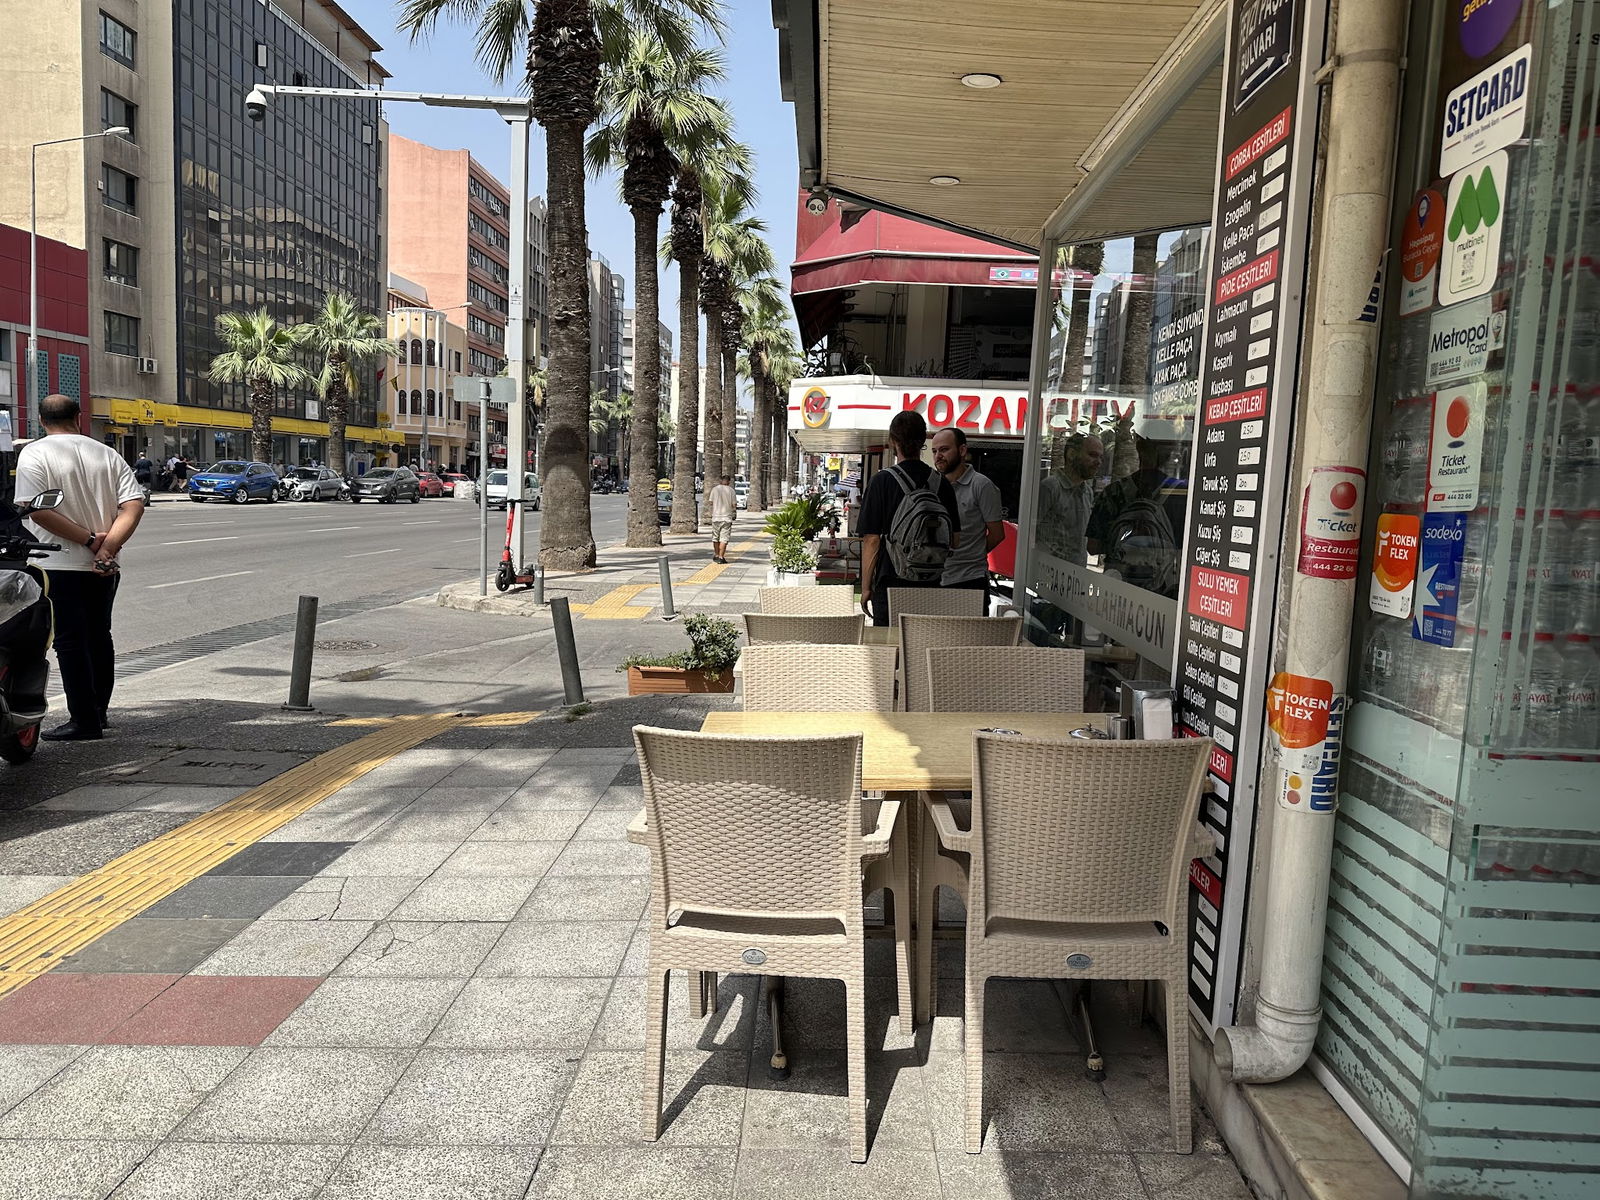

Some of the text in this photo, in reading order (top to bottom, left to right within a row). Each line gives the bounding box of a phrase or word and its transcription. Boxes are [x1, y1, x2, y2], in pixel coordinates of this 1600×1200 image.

[1240, 21, 1277, 76] BULVARI
[1446, 57, 1527, 138] SETCARD
[1230, 113, 1286, 176] ÇORBA ÇEŞİTLERİ
[1227, 168, 1257, 203] Mercimek
[1225, 199, 1251, 228] Ezogelin
[1222, 231, 1238, 252] Kelle
[1238, 223, 1254, 243] Paça
[1221, 250, 1247, 276] İşkembe
[1220, 255, 1273, 299] PİDE ÇEŞİTLERİ
[1217, 299, 1248, 323] Lahmacun
[1157, 315, 1177, 344] KENDİ
[1214, 325, 1238, 348] Kıymalı
[1431, 317, 1489, 354] Metropol
[1155, 335, 1194, 365] KELLE PAÇA
[1468, 340, 1488, 356] Card
[1153, 360, 1188, 386] AYAK PAÇA
[1212, 351, 1234, 372] Kaşarlı
[1178, 378, 1199, 403] ÇORB
[1210, 378, 1234, 396] Kuşbaşı
[1208, 391, 1264, 420] KEBAP ÇEŞİTLERİ
[1205, 428, 1225, 443] Adana
[1204, 452, 1217, 467] Urfa
[1441, 455, 1466, 467] Ticket
[1202, 475, 1219, 491] Tavuk
[1219, 475, 1229, 494] Şiş
[1200, 500, 1217, 515] Kanat
[1217, 500, 1227, 518] Şiş
[1197, 523, 1212, 539] Kuzu
[1212, 525, 1222, 542] Şiş
[1391, 533, 1417, 548] TOKEN
[1424, 525, 1463, 542] sodexo
[1195, 546, 1211, 565] Ciğer
[1211, 549, 1220, 568] Şiş
[1389, 547, 1409, 561] FLEX
[1312, 562, 1331, 571] 444
[1333, 564, 1344, 572] 22
[1198, 571, 1239, 595] SULU YEMEK
[1200, 594, 1233, 618] ÇEŞİTLERİ
[1284, 691, 1329, 711] TOKEN
[1284, 705, 1313, 721] FLEX
[1309, 696, 1345, 811] SETCARD
